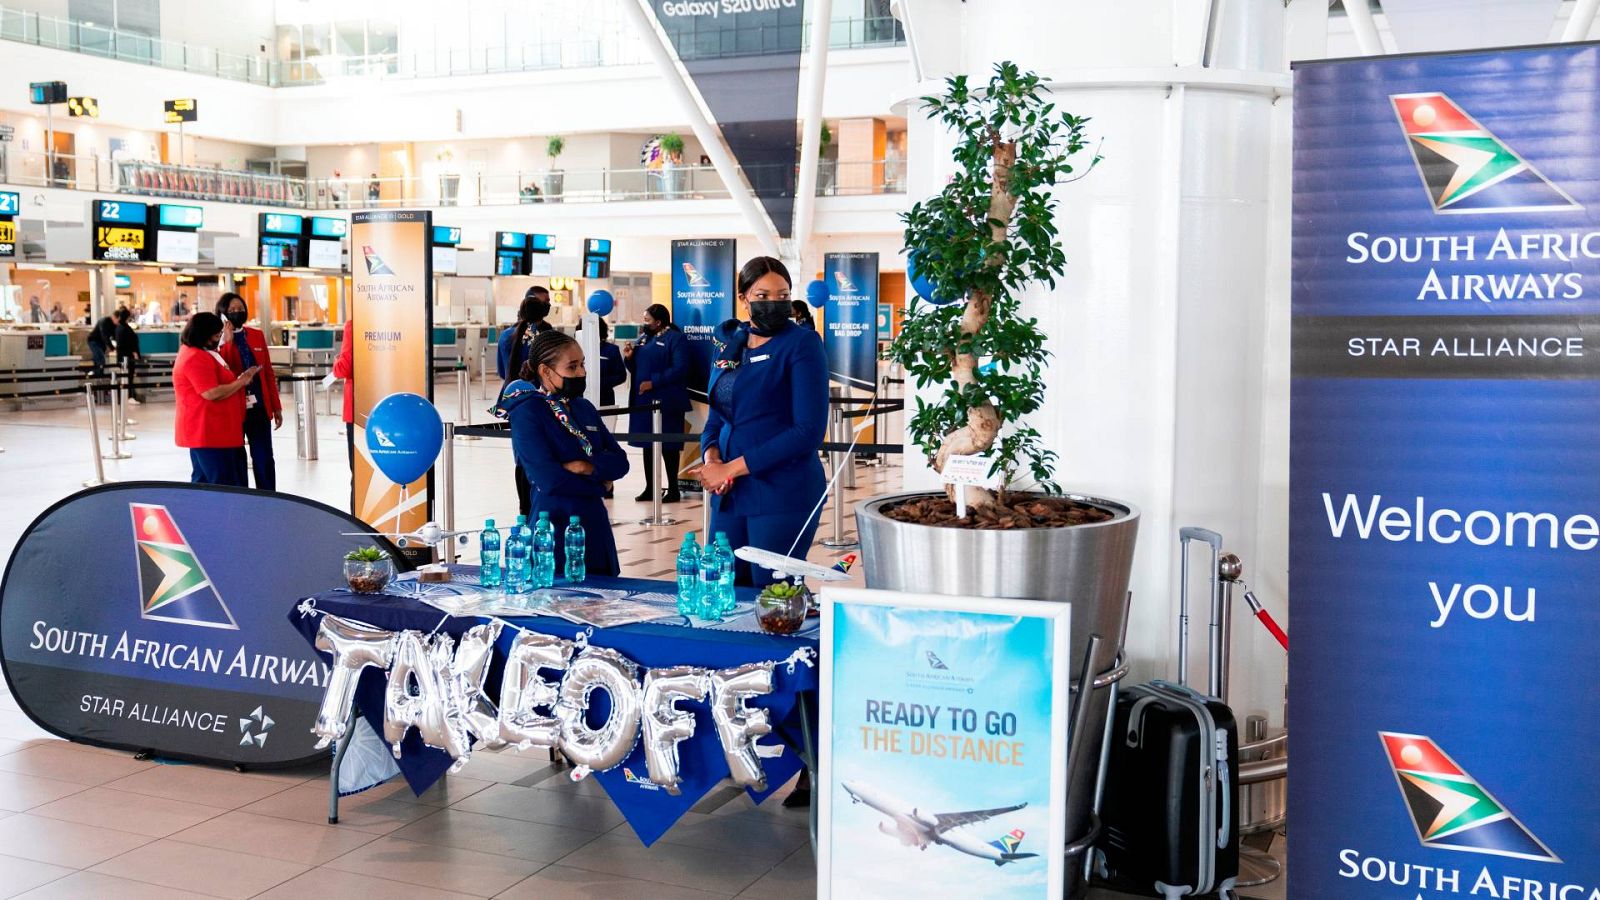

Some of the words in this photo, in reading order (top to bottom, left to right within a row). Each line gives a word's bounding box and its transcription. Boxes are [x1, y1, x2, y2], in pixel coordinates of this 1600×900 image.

[663, 0, 718, 18] Galaxy
[721, 0, 751, 14] S20
[0, 194, 18, 211] 21
[102, 202, 120, 218] 22
[266, 215, 282, 230] 24
[1346, 232, 1475, 263] SOUTH
[1485, 227, 1600, 262] AFRIC
[357, 283, 377, 292] SOUTH
[378, 283, 414, 292] AFRICAN
[367, 293, 398, 301] AIRWAYS
[1417, 268, 1583, 302] AIRWAYS
[365, 331, 401, 341] PREMIUM
[1348, 338, 1420, 356] STAR
[1431, 338, 1583, 356] ALLIANCE
[1322, 492, 1600, 551] Welcome
[1428, 581, 1537, 628] you
[30, 620, 108, 658] SOUTH
[111, 630, 223, 674] AFRICAN
[225, 645, 331, 688] AIRWAY
[80, 695, 124, 717] STAR
[128, 703, 228, 733] ALLIANCE
[310, 613, 773, 795] TAKEOFF
[866, 699, 941, 729] READY
[947, 707, 977, 733] TO
[985, 711, 1017, 736] GO
[859, 726, 902, 753] THE
[911, 731, 1025, 767] DISTANCE
[1338, 848, 1460, 893] SOUTH
[1470, 866, 1600, 900] AFRIC
